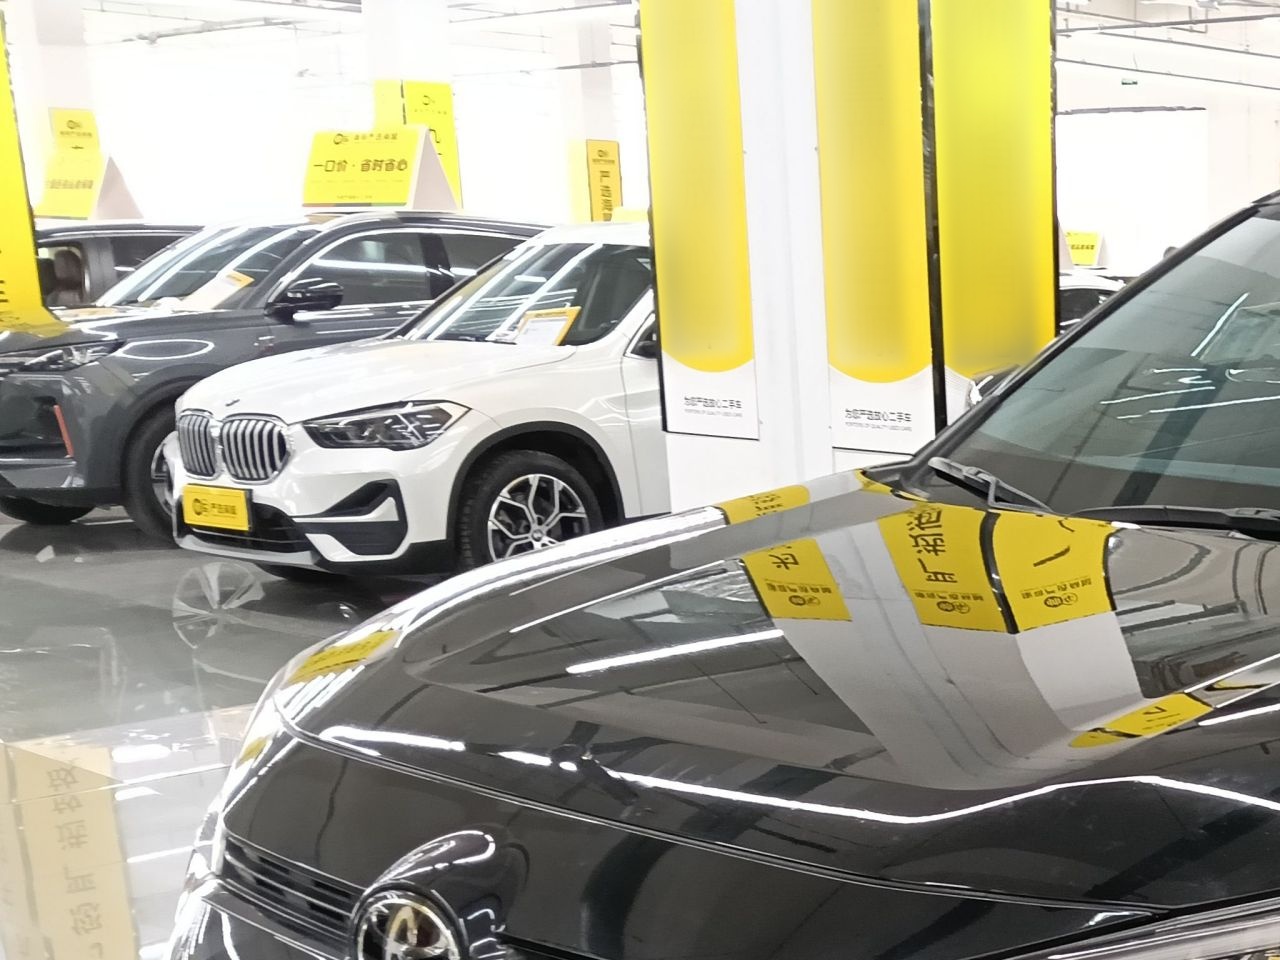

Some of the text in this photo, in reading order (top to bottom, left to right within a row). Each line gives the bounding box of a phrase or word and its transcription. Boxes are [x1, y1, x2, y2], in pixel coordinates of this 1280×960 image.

[844, 407, 912, 423] 为您严选放心二手车
